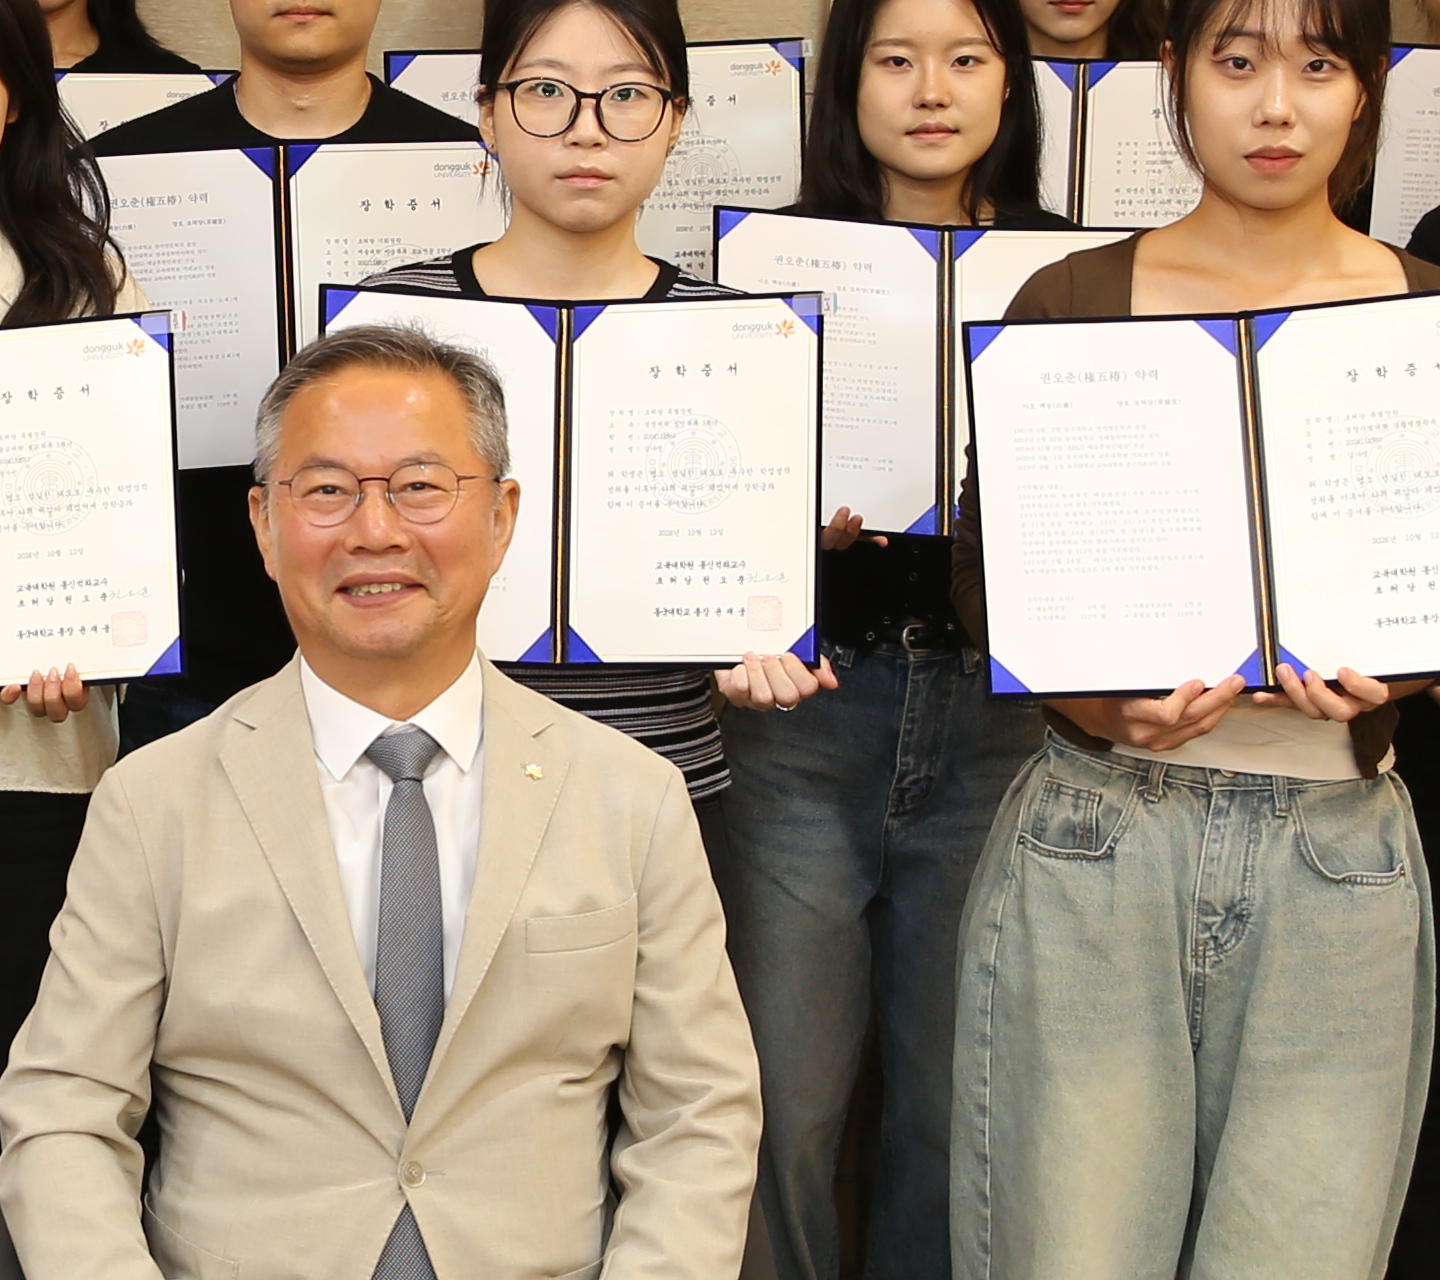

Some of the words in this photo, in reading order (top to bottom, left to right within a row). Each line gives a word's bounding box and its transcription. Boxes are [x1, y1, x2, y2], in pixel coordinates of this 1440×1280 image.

[730, 62, 762, 71] dongguk
[434, 162, 471, 173] dongguk
[434, 170, 471, 178] UNIVERSITY
[360, 199, 371, 212] 장
[384, 199, 395, 211] 학
[407, 198, 418, 211] 증
[431, 198, 440, 210] 서
[732, 322, 773, 334] dongguk
[83, 341, 124, 354] dongguk
[649, 365, 661, 379] 장
[676, 365, 687, 377] 학
[701, 364, 712, 377] 증
[727, 363, 737, 376] 서
[1346, 369, 1359, 382] 장
[1376, 366, 1388, 378] 학
[1405, 363, 1417, 377] 증
[1, 391, 12, 404] 장
[28, 389, 39, 401] 학
[53, 387, 64, 400] 증
[80, 384, 89, 396] 서
